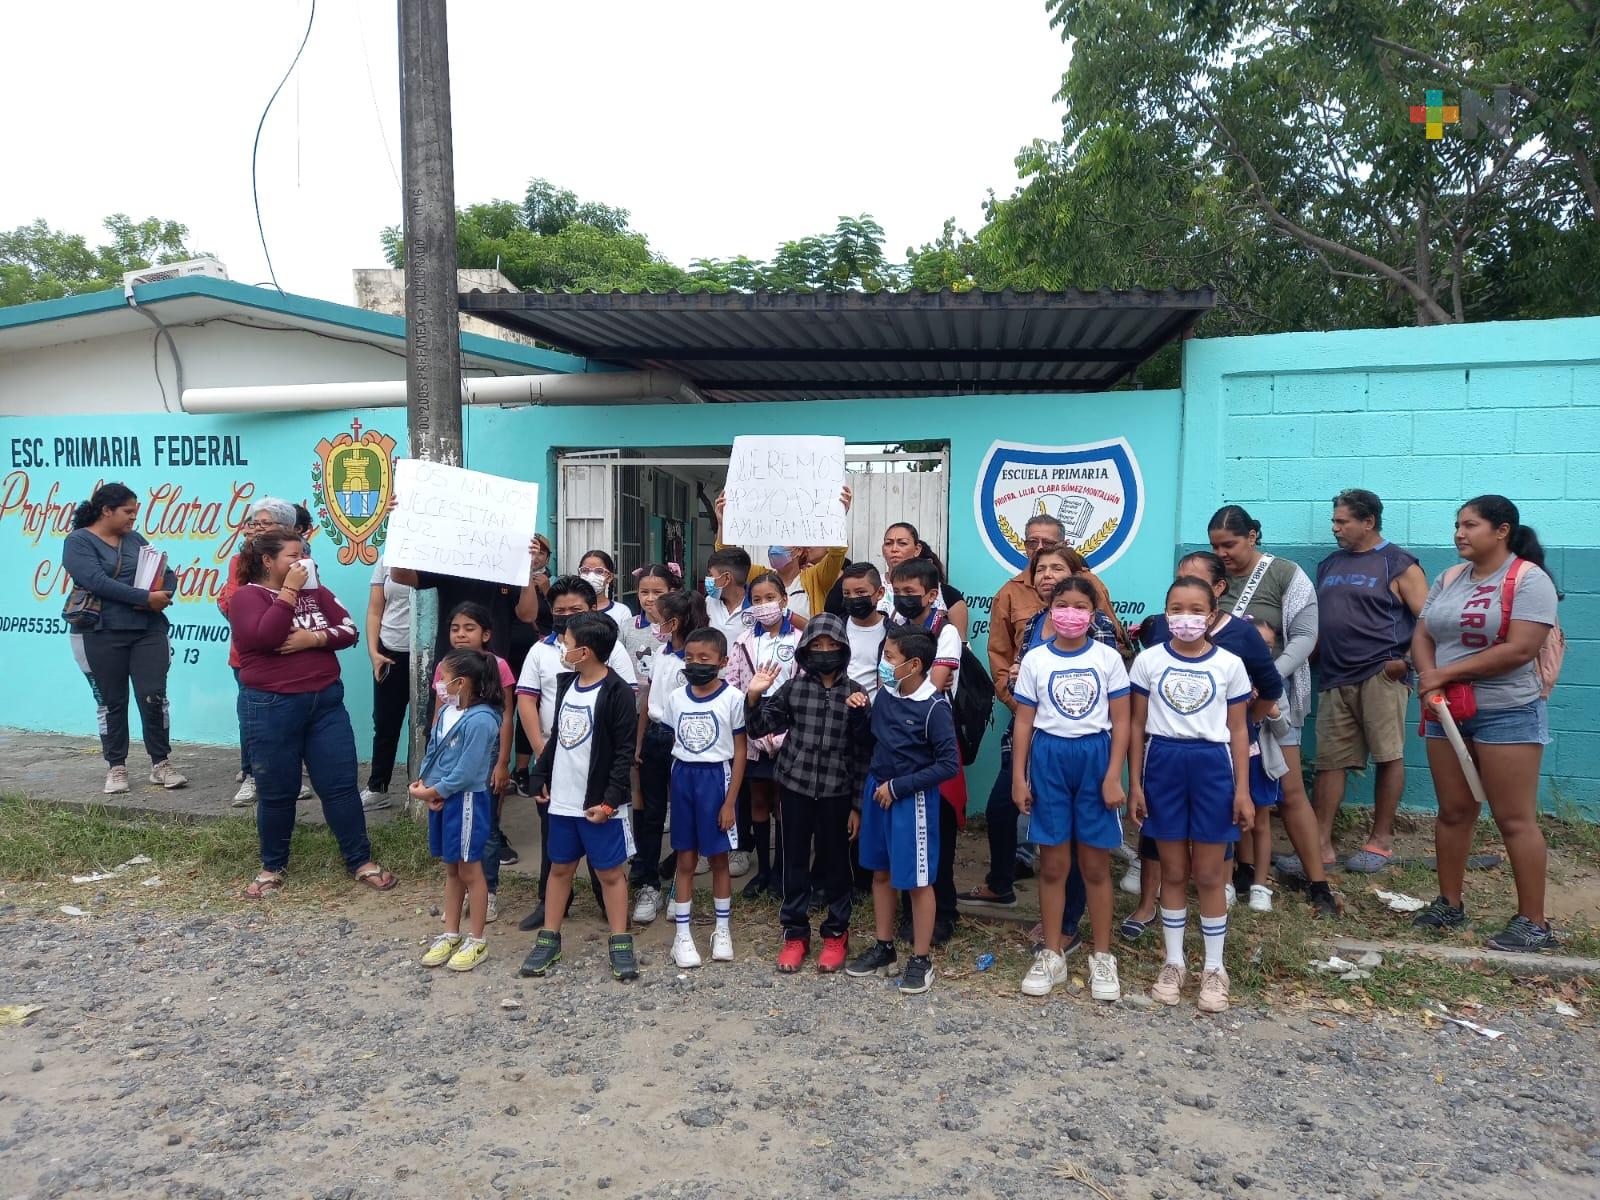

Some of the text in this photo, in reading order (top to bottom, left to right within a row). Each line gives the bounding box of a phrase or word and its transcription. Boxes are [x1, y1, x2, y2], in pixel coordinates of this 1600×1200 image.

[11, 435, 248, 468] ESC. PRIMARIA FEDERAL
[729, 446, 844, 482] QUEREMOS
[1002, 468, 1110, 480] ESCUELA PRIMARIA
[1037, 484, 1060, 493] CLARA
[144, 482, 222, 536] Clara
[793, 487, 845, 518] DEL
[398, 537, 508, 573] ESTUDIAR
[456, 526, 512, 553] PARA
[1460, 585, 1498, 649] AERO
[167, 623, 231, 643] ONTINUO
[183, 647, 200, 665] 13
